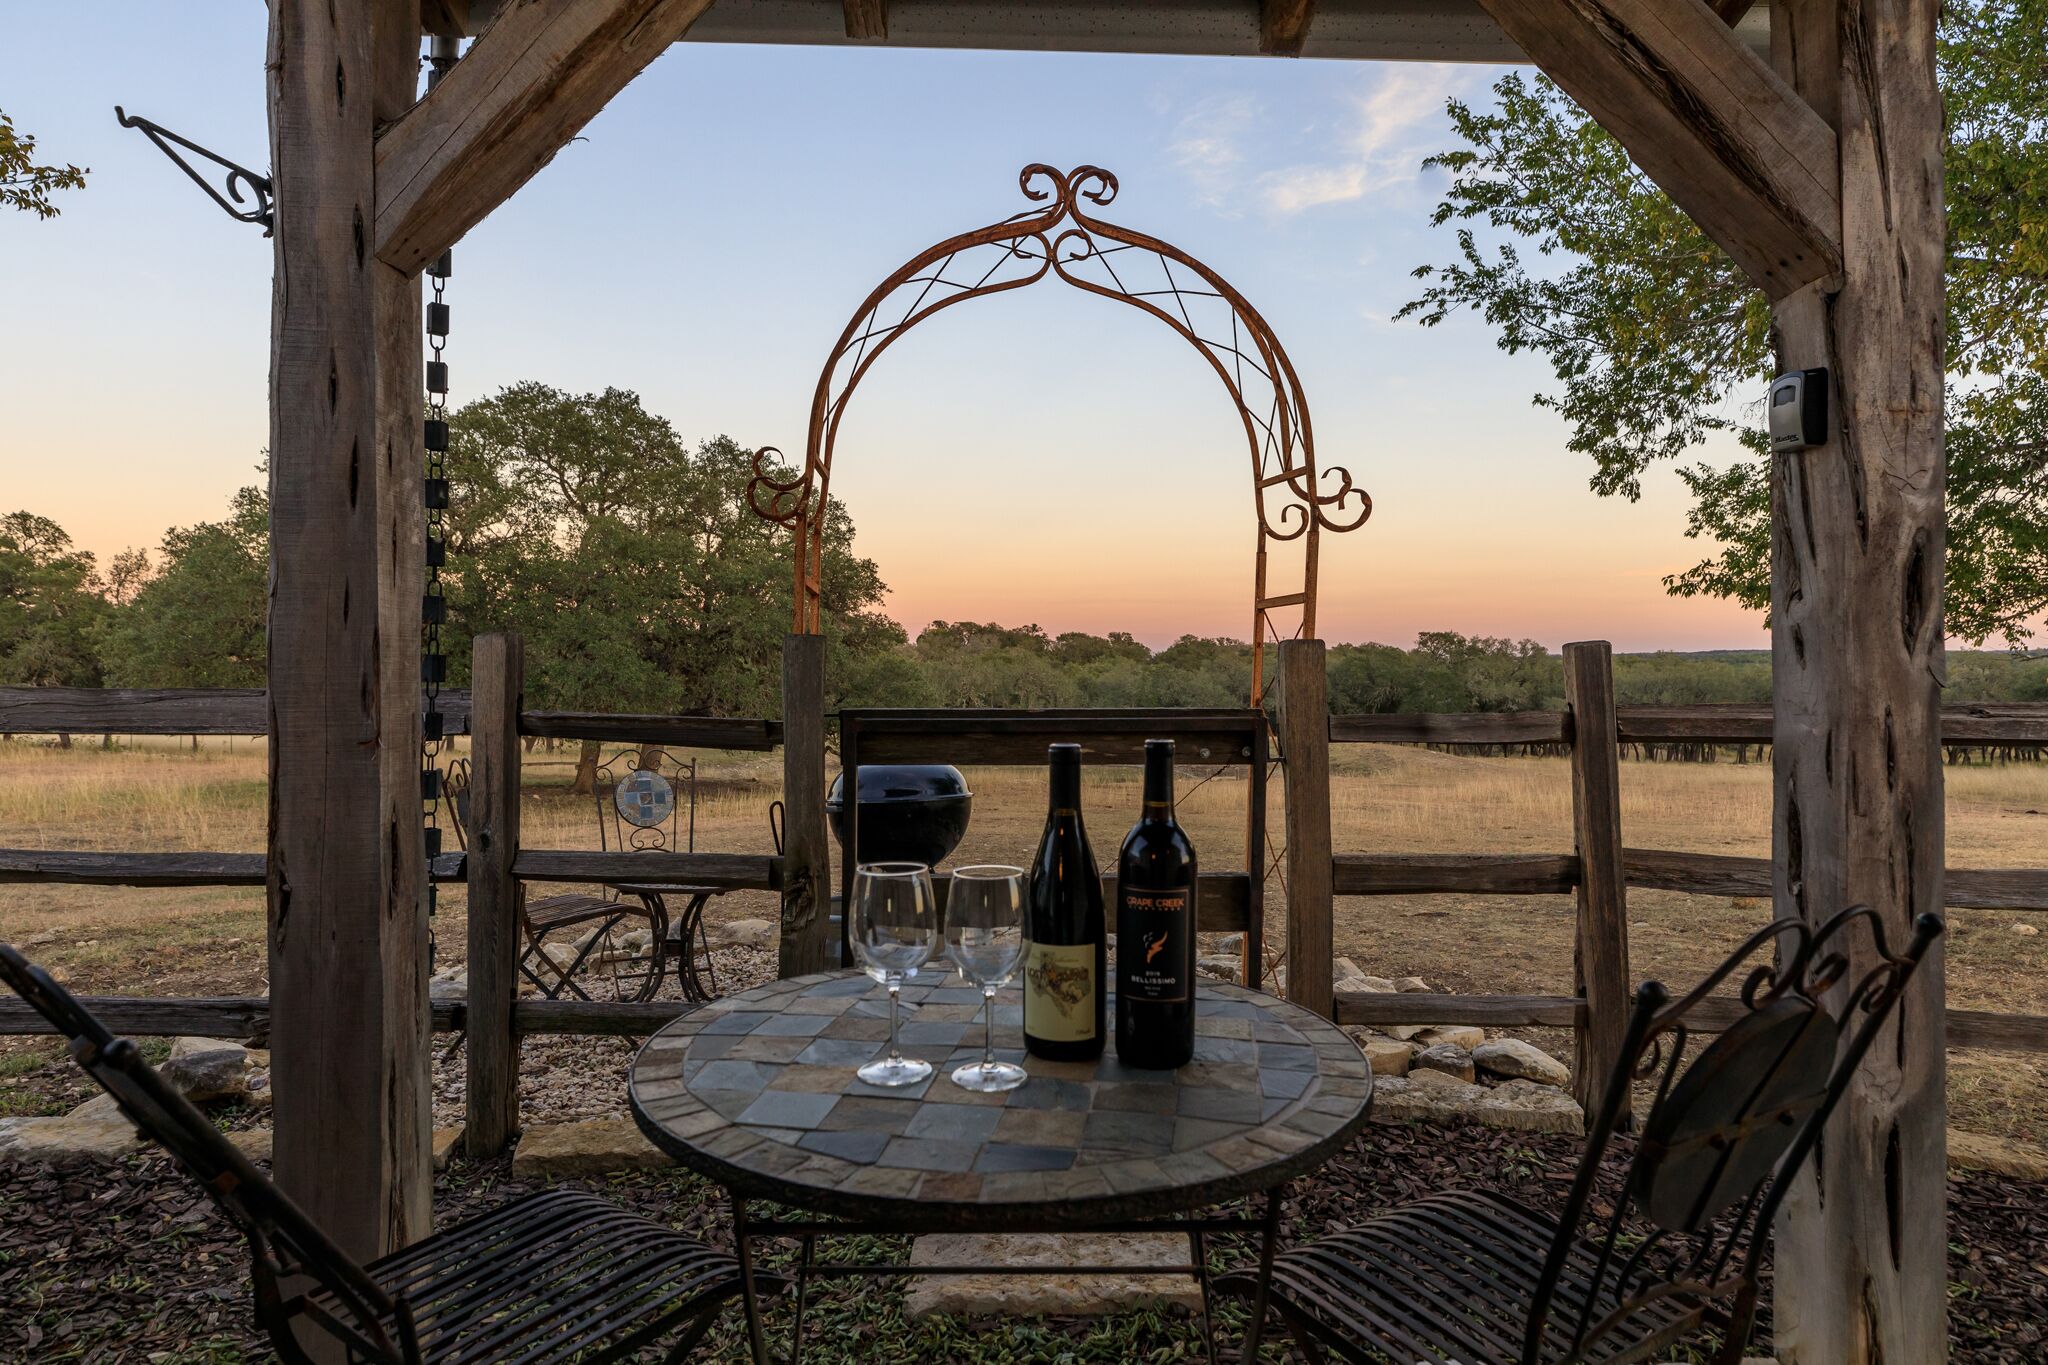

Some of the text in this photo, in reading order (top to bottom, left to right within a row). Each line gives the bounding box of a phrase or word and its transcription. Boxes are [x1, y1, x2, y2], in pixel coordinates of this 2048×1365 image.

[1126, 896, 1185, 907] GRAPE CREEK
[1131, 975, 1176, 985] BELLISSIMO
